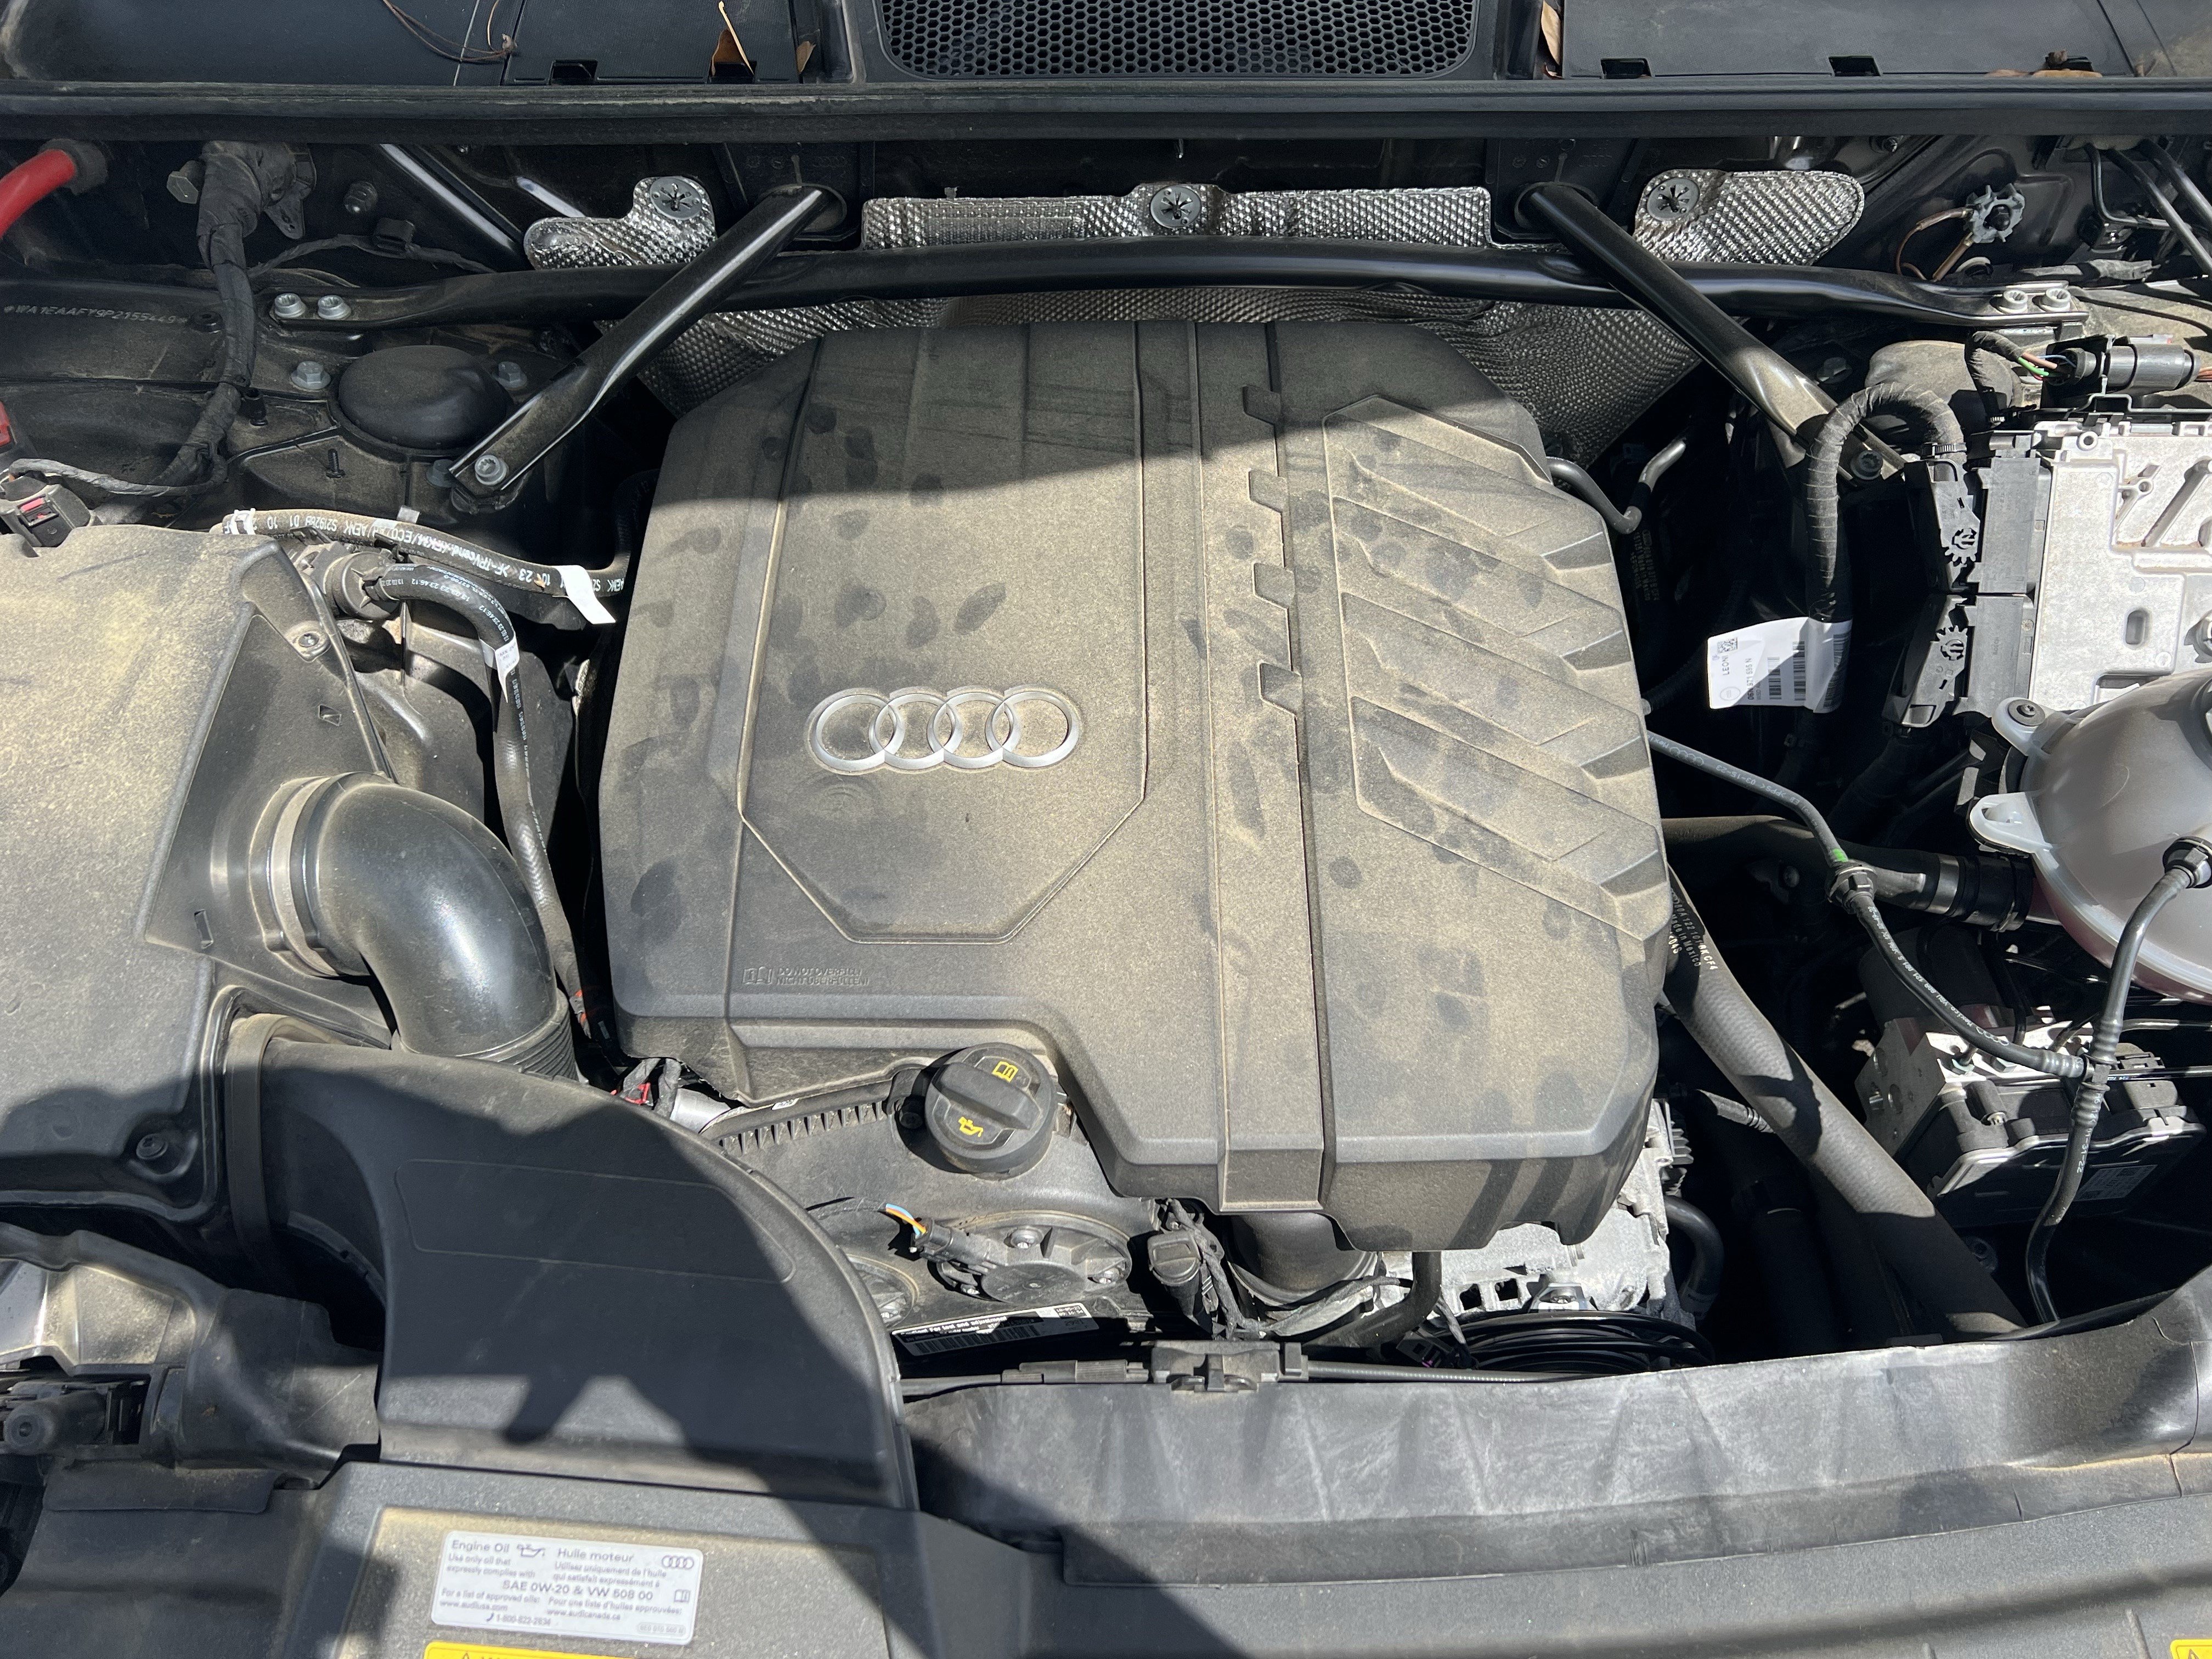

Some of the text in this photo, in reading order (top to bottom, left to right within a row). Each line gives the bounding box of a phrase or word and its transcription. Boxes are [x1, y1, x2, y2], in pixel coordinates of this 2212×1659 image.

[267, 516, 278, 530] 10
[518, 568, 533, 583] 23
[1682, 917, 1696, 931] 122
[1690, 931, 1704, 944] 101
[1683, 940, 1701, 967] Mexico
[1950, 1006, 1973, 1028] Mexico
[970, 1316, 1007, 1326] adjustment
[452, 1540, 510, 1553] Engine Oil
[448, 1553, 511, 1566] Use only oil that
[557, 1547, 635, 1562] Huile moteur
[447, 1565, 482, 1576] expressly
[483, 1568, 517, 1577] complies
[583, 1565, 630, 1576] uniquement
[553, 1573, 567, 1582] qui
[441, 1587, 454, 1598] For
[462, 1590, 475, 1599] list
[476, 1590, 485, 1599] of
[486, 1593, 522, 1603] approved
[503, 1579, 653, 1601] SAE 0W-20 & VW 508 00
[440, 1601, 508, 1611] www.audiusa.com
[548, 1596, 566, 1606] Pour
[585, 1599, 601, 1608] liste
